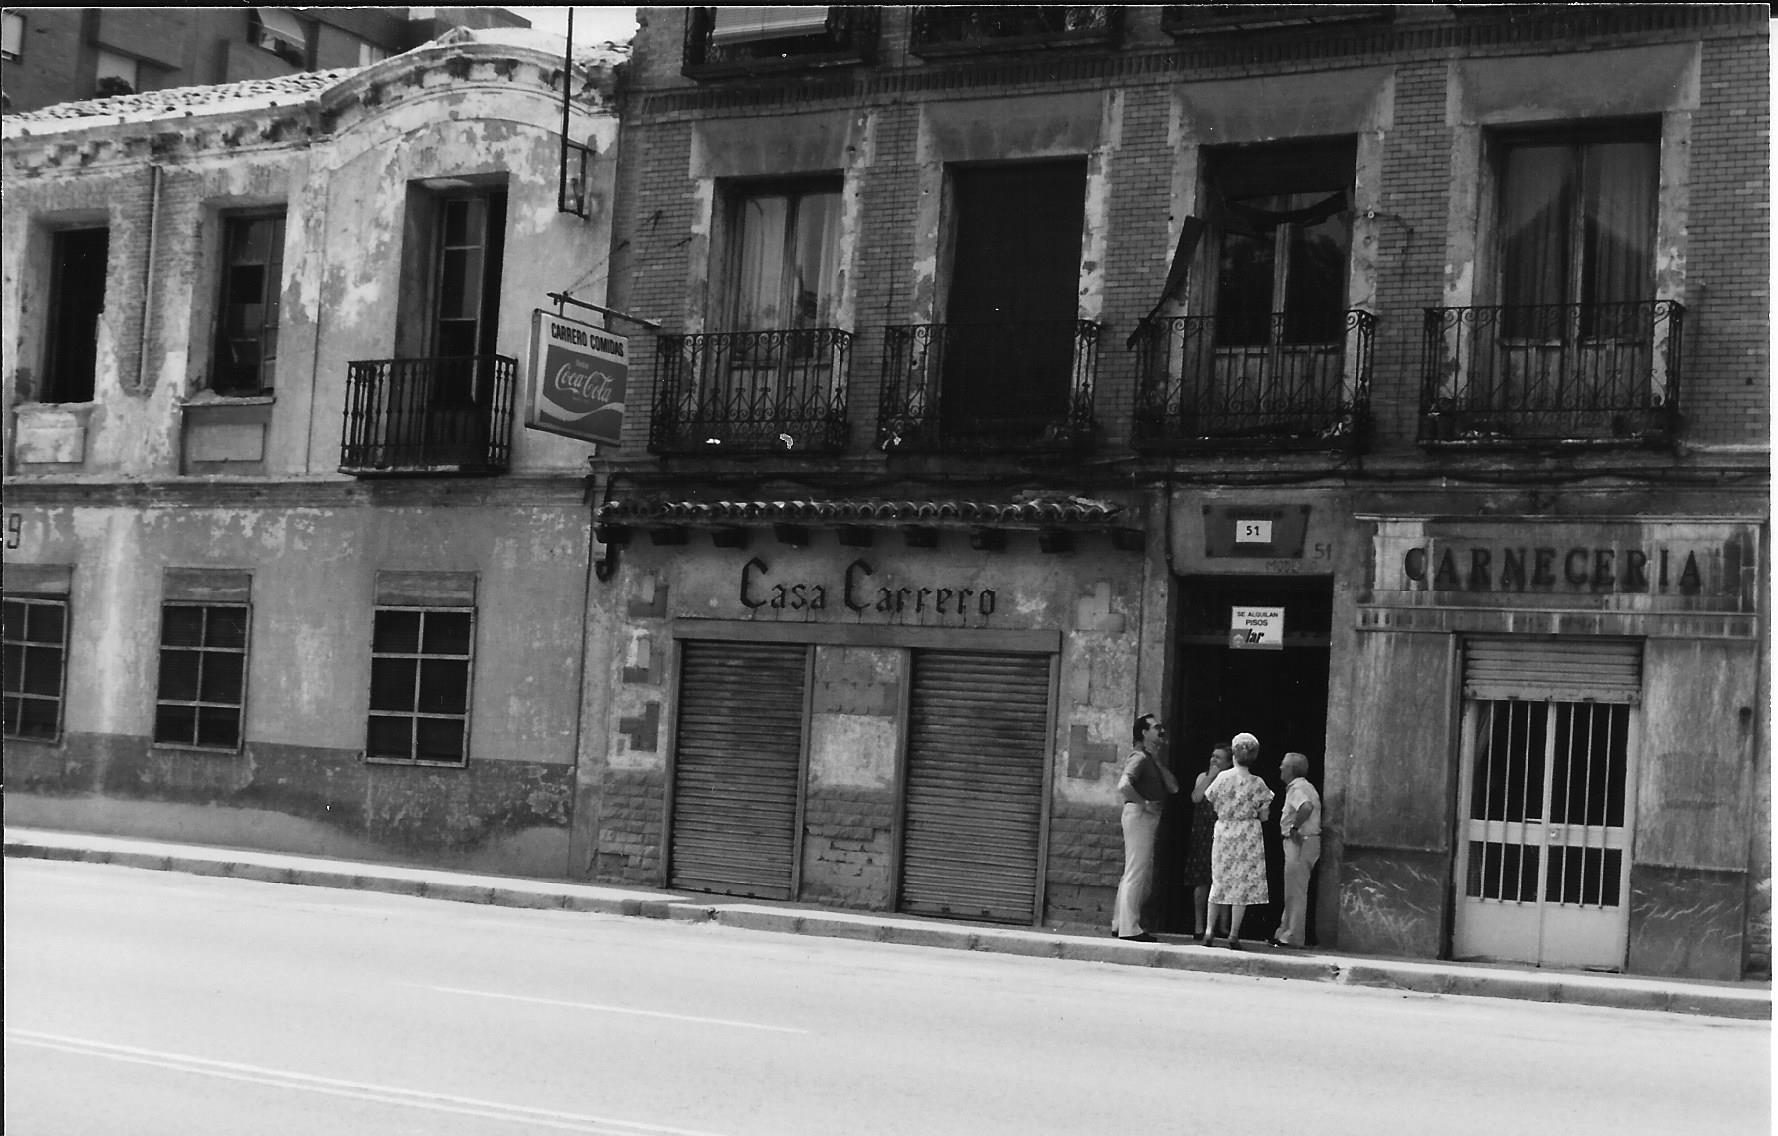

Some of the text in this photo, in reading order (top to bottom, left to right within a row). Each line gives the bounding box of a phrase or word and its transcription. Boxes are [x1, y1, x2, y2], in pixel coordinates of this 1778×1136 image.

[551, 323, 625, 357] CARRERO COMIDAS
[1246, 525, 1260, 536] 51
[1314, 543, 1332, 560] 51
[1404, 547, 1703, 589] CARNECERIA
[740, 557, 997, 615] Casa Carrero
[1245, 628, 1265, 643] lar
